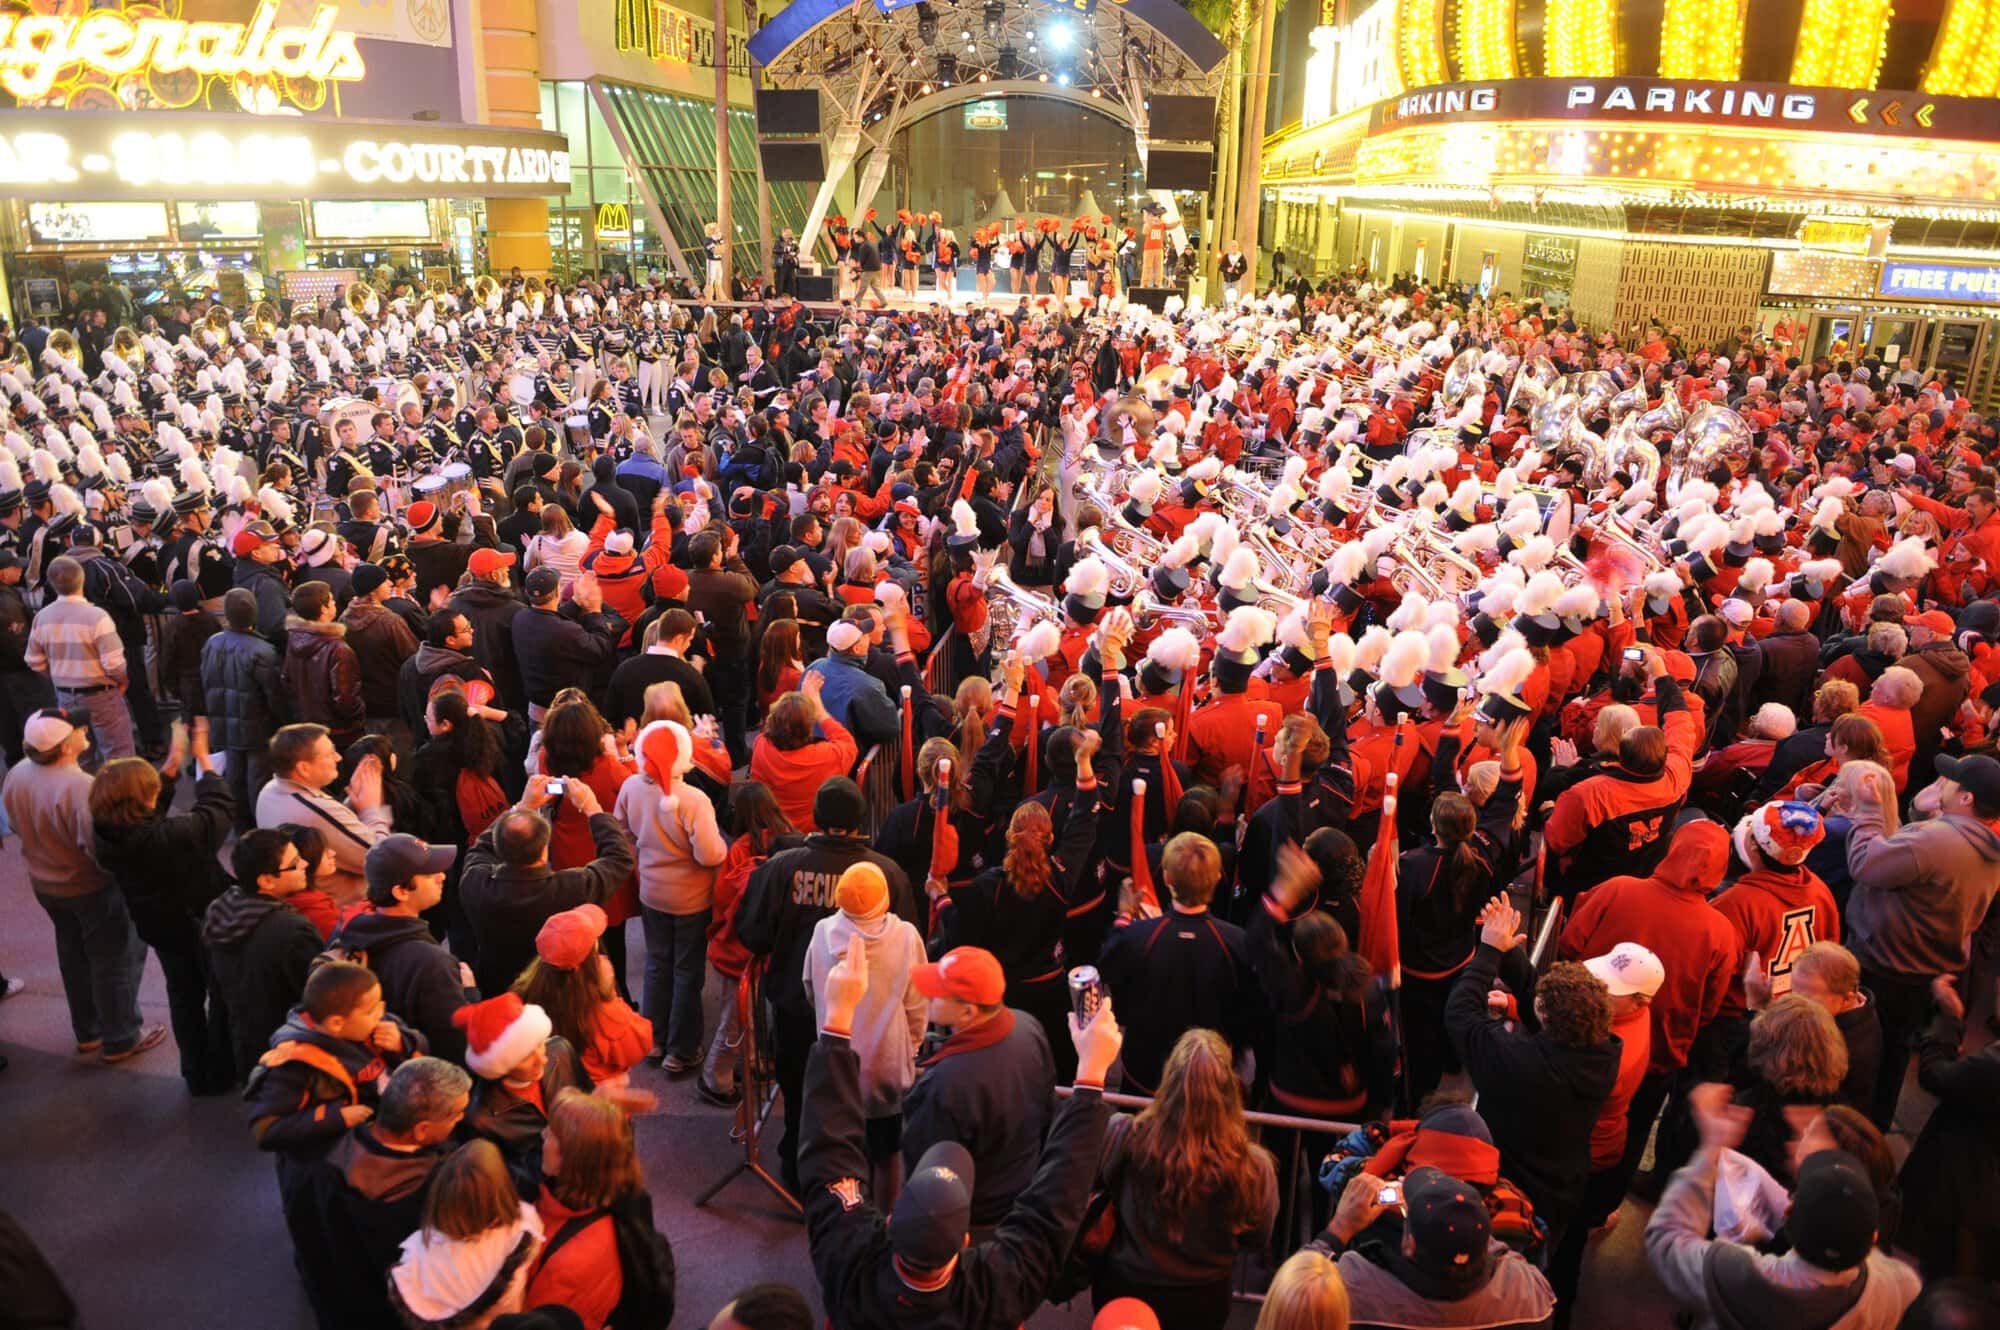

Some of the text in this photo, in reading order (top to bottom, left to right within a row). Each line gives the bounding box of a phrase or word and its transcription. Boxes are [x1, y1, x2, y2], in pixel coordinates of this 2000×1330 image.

[1566, 85, 1816, 120] PARKING
[344, 140, 549, 183] COURTYARD
[1890, 267, 1947, 290] FREE
[792, 869, 842, 909] SECU
[1768, 905, 1816, 977] A
